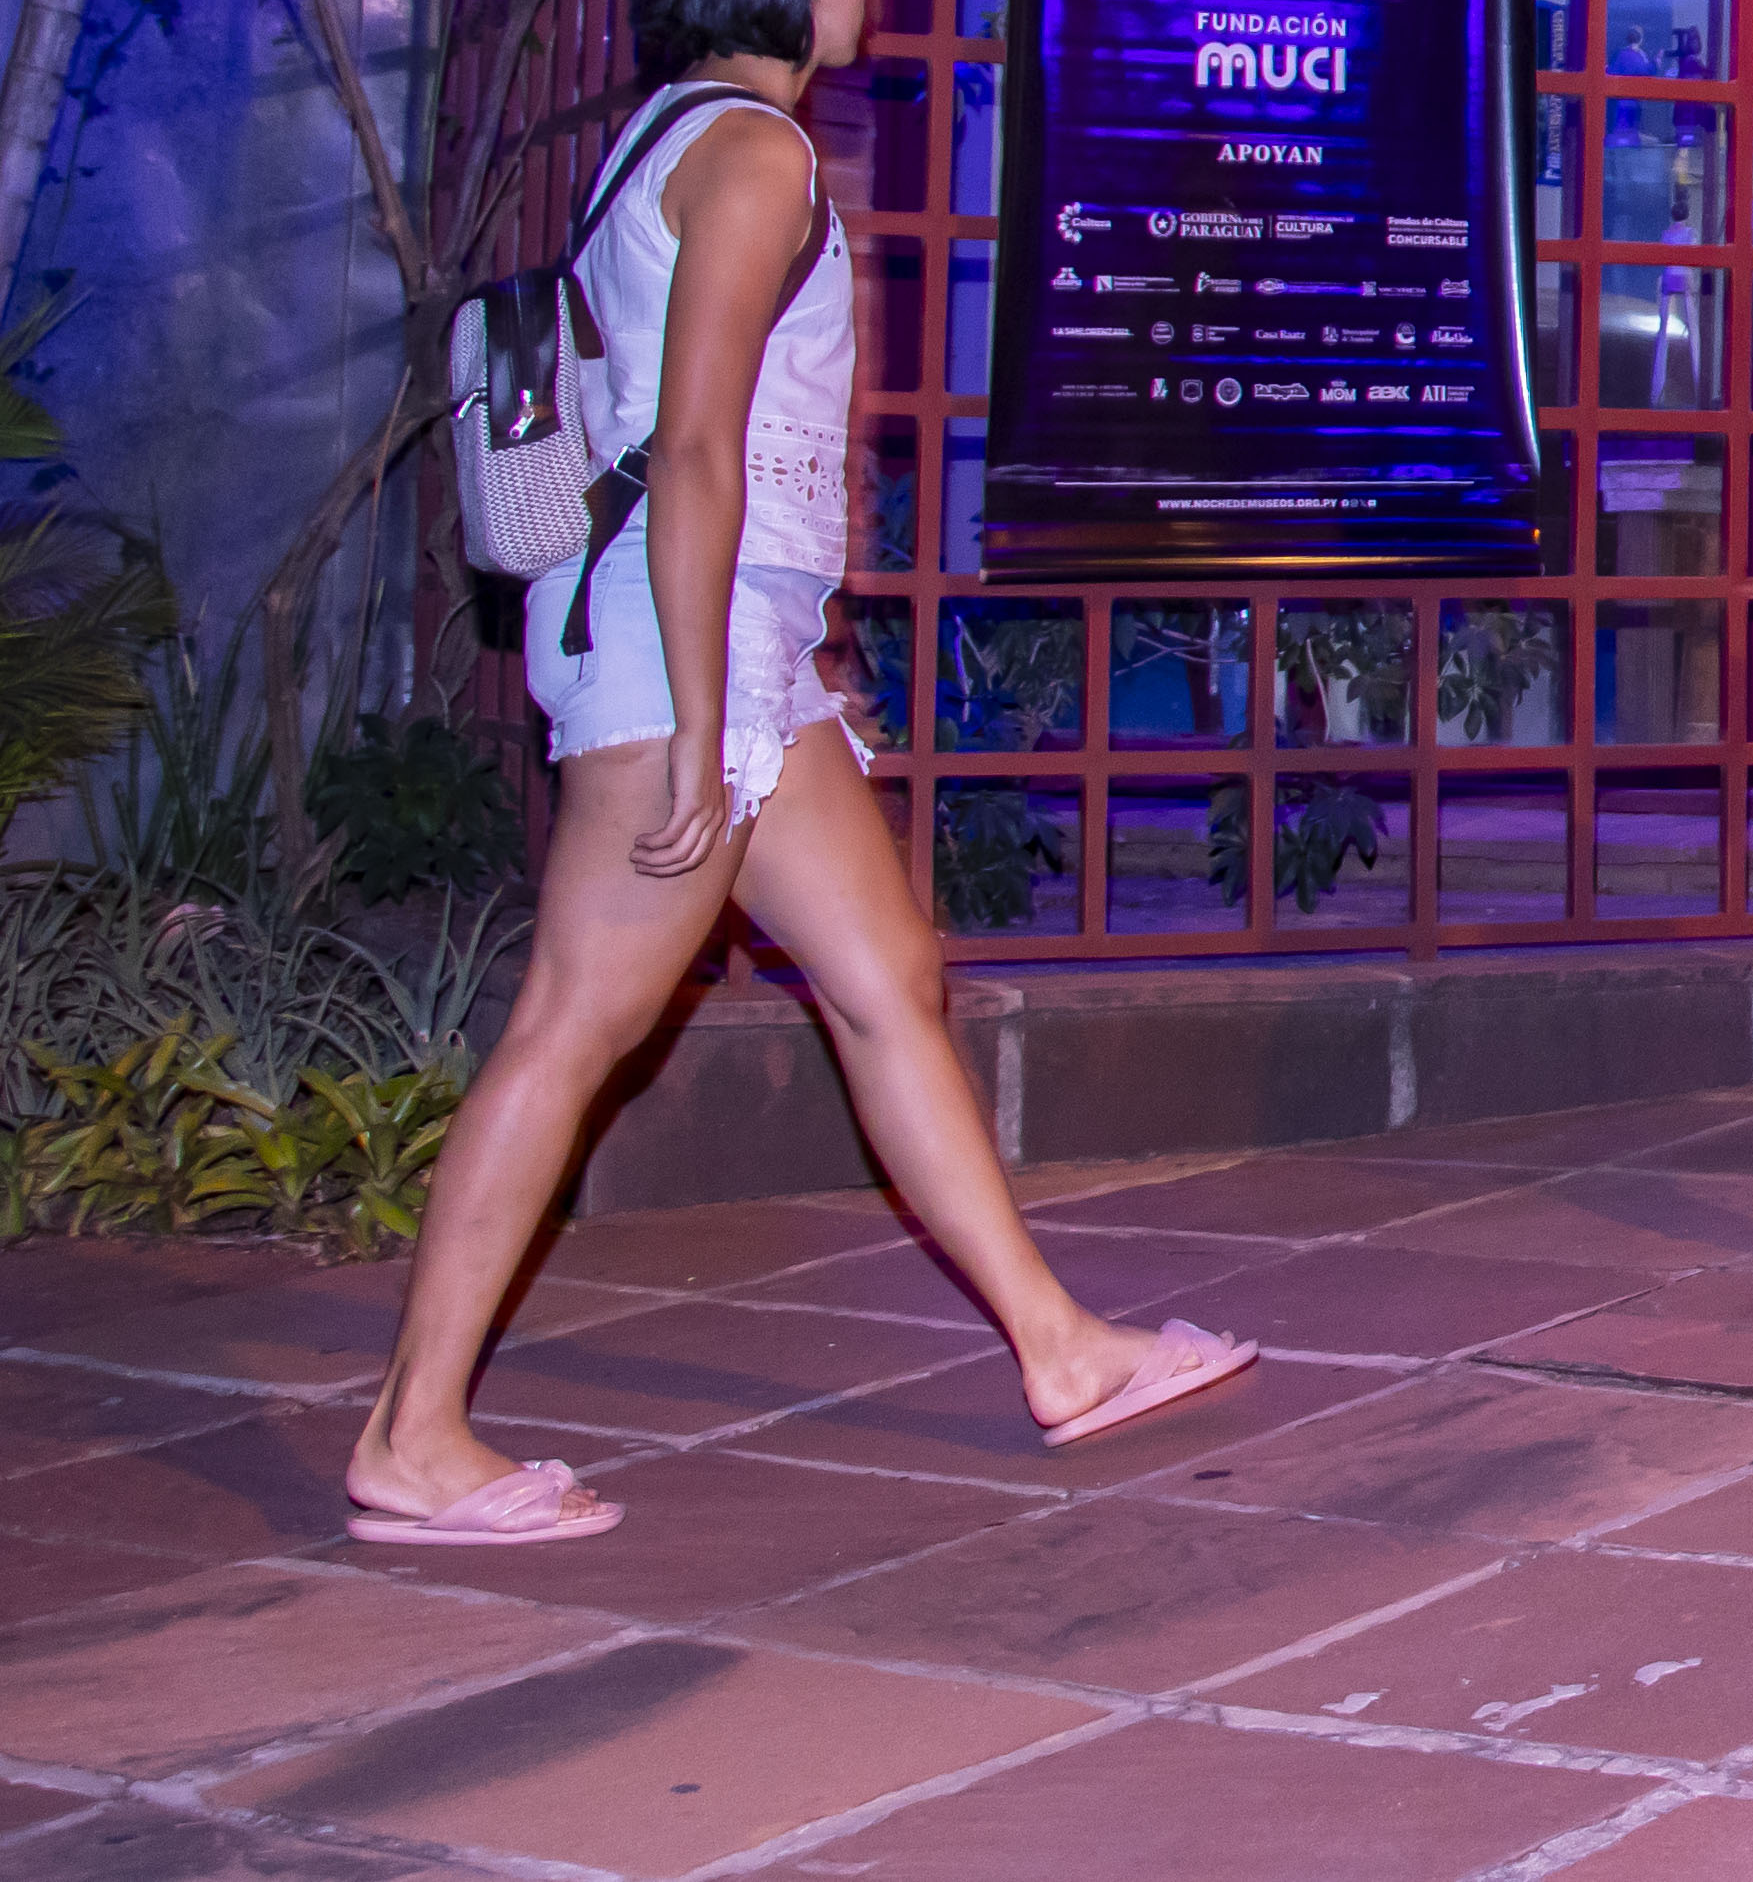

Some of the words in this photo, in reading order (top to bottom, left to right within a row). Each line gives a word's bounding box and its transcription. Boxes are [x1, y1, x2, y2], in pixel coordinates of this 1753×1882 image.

[1197, 12, 1347, 37] FUNDACIÓN
[1218, 144, 1324, 165] APOYAN
[1180, 223, 1264, 239] PARAGUAY
[1275, 221, 1334, 234] CULTURA
[1387, 234, 1469, 247] CONCURSABLE
[1422, 384, 1446, 403] ATI
